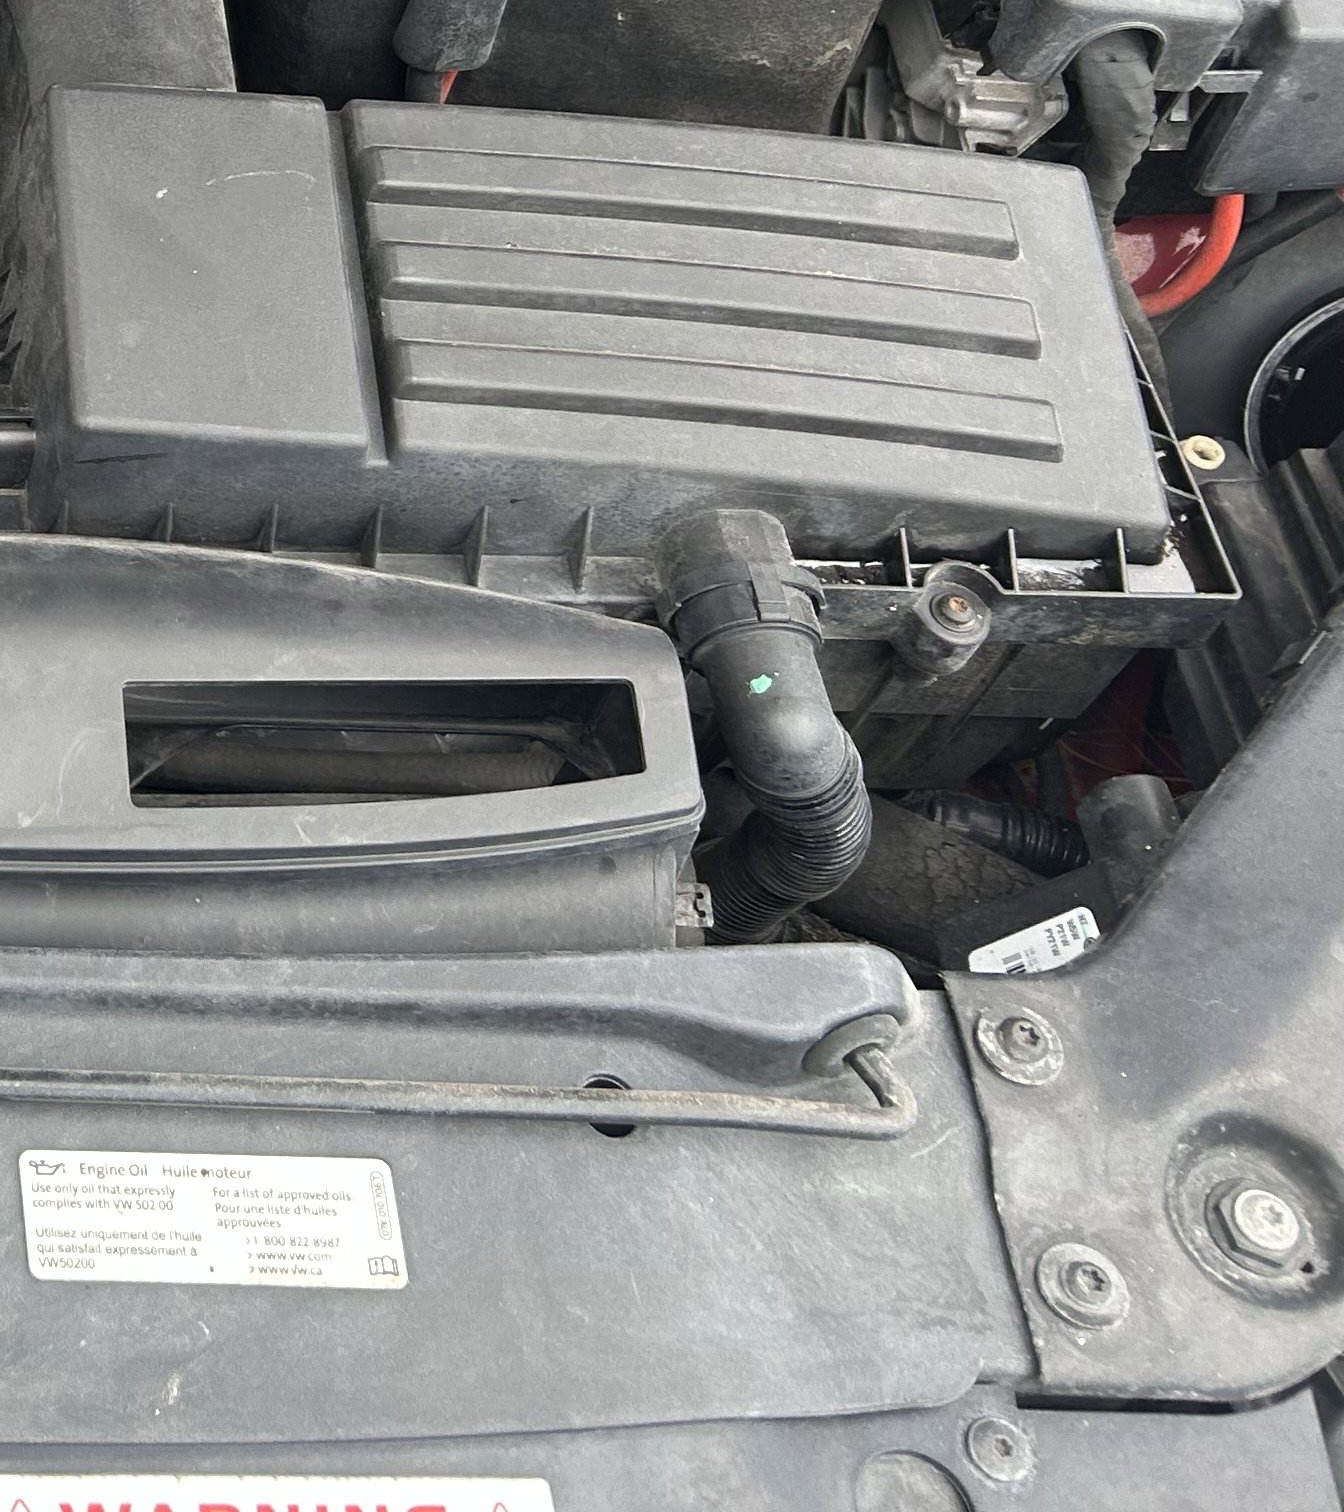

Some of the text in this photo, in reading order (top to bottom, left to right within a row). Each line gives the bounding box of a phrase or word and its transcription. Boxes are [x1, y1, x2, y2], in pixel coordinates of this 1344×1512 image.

[79, 1162, 126, 1179] Engine
[129, 1164, 148, 1176] Oil
[163, 1164, 198, 1178] Huile
[31, 1182, 176, 1199] Use only oil that expressly
[212, 1186, 230, 1199] For
[233, 1189, 240, 1198] a
[242, 1188, 260, 1199] list
[262, 1188, 274, 1199] of
[278, 1191, 329, 1203] approved
[32, 1198, 174, 1211] complies with VW 502 00
[215, 1203, 337, 1217] Pour une liste d'huiles
[217, 1217, 282, 1229] approuvées
[35, 1227, 202, 1242] Utilisez uniquement de l'huile
[264, 1236, 286, 1246] 800
[37, 1243, 198, 1257] qui satisfait expressément à
[38, 1257, 96, 1269] VW50200
